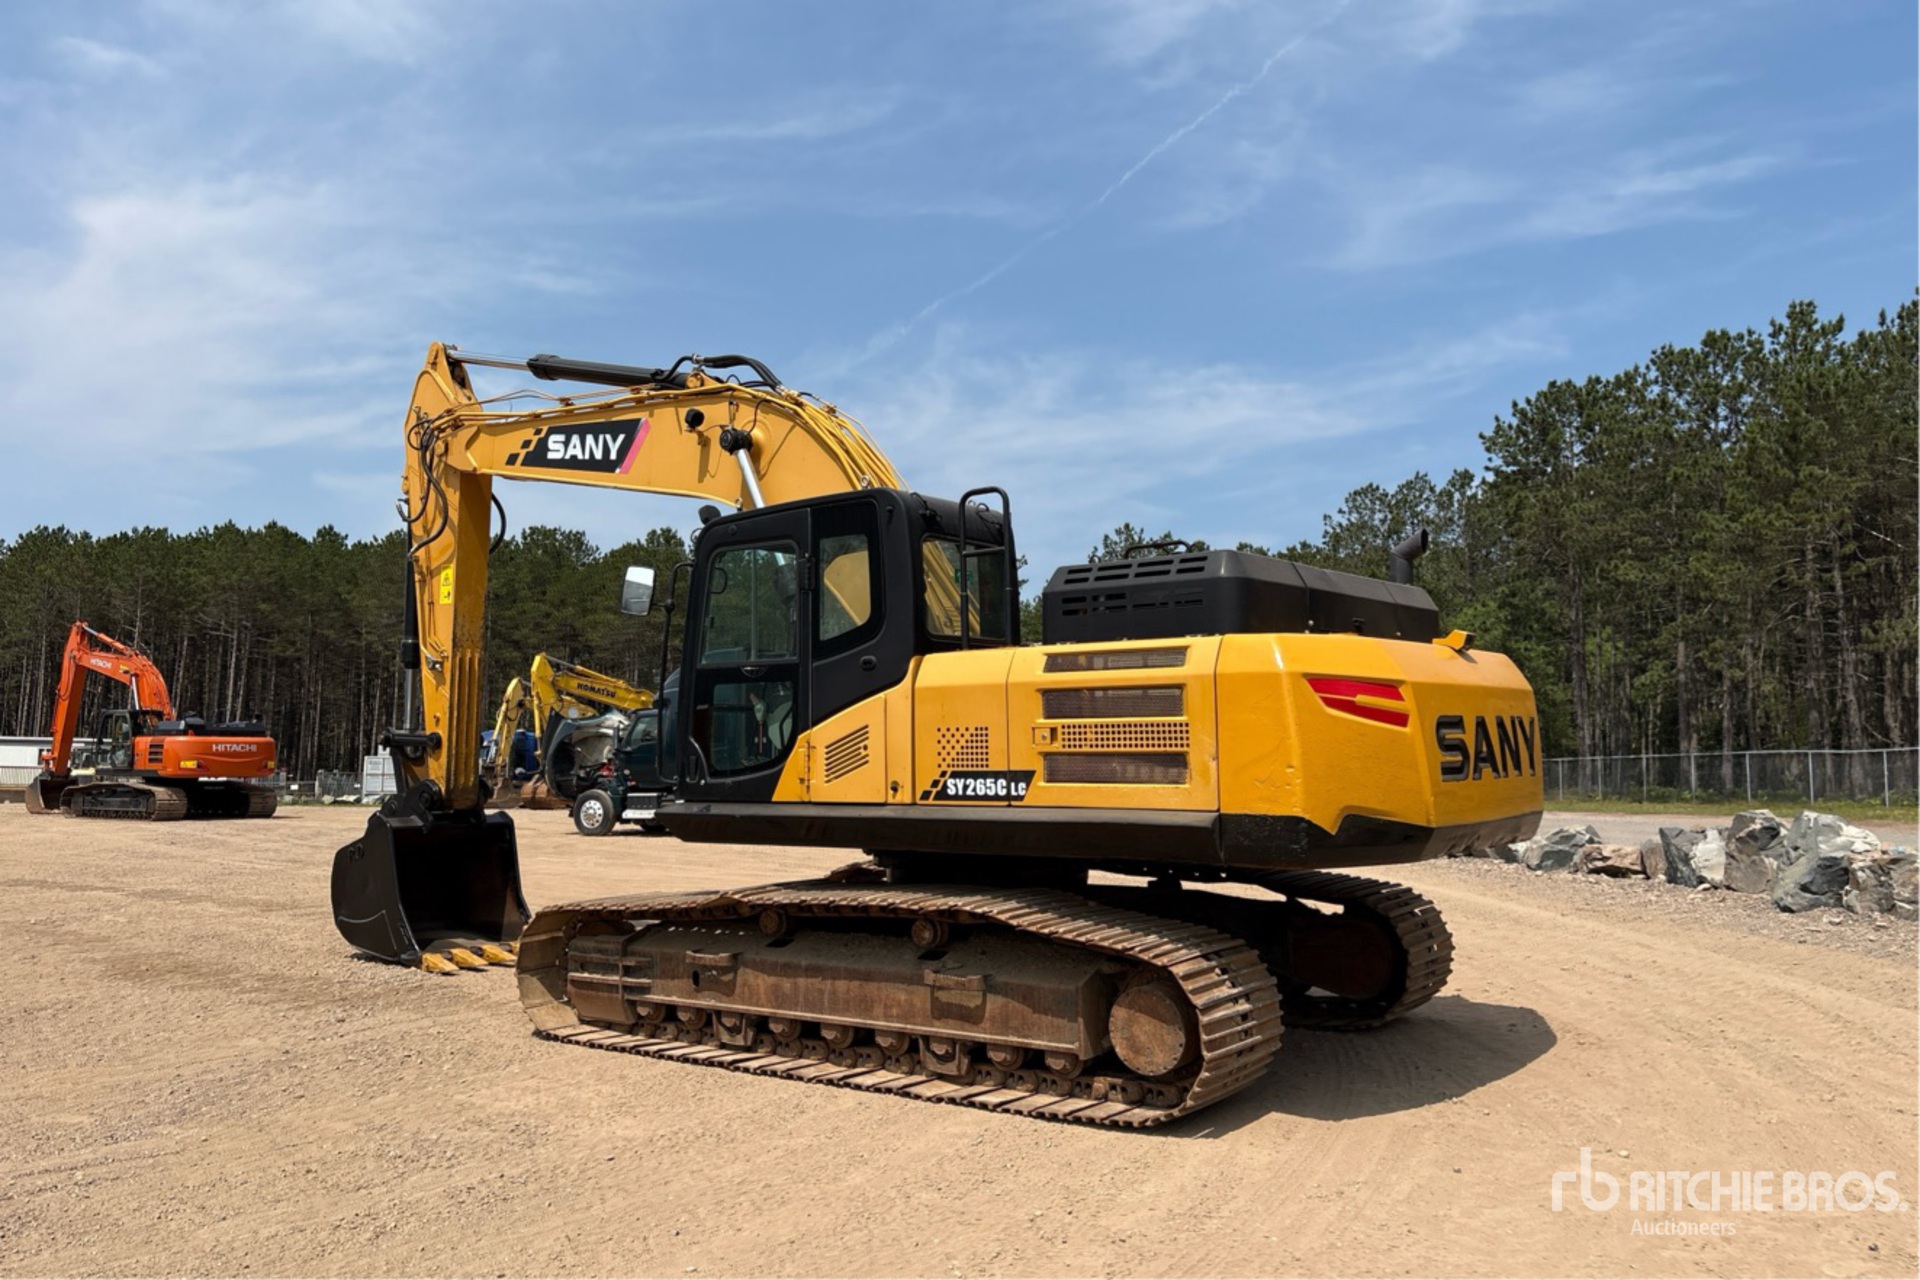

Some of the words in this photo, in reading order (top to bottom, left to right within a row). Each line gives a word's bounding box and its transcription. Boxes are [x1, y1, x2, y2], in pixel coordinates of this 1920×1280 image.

[547, 433, 626, 460] SANY
[577, 682, 616, 698] KOMATSU
[212, 743, 257, 752] HITACHI
[1435, 715, 1536, 782] SANY
[946, 778, 1008, 796] SY265C
[1010, 782, 1027, 796] LC
